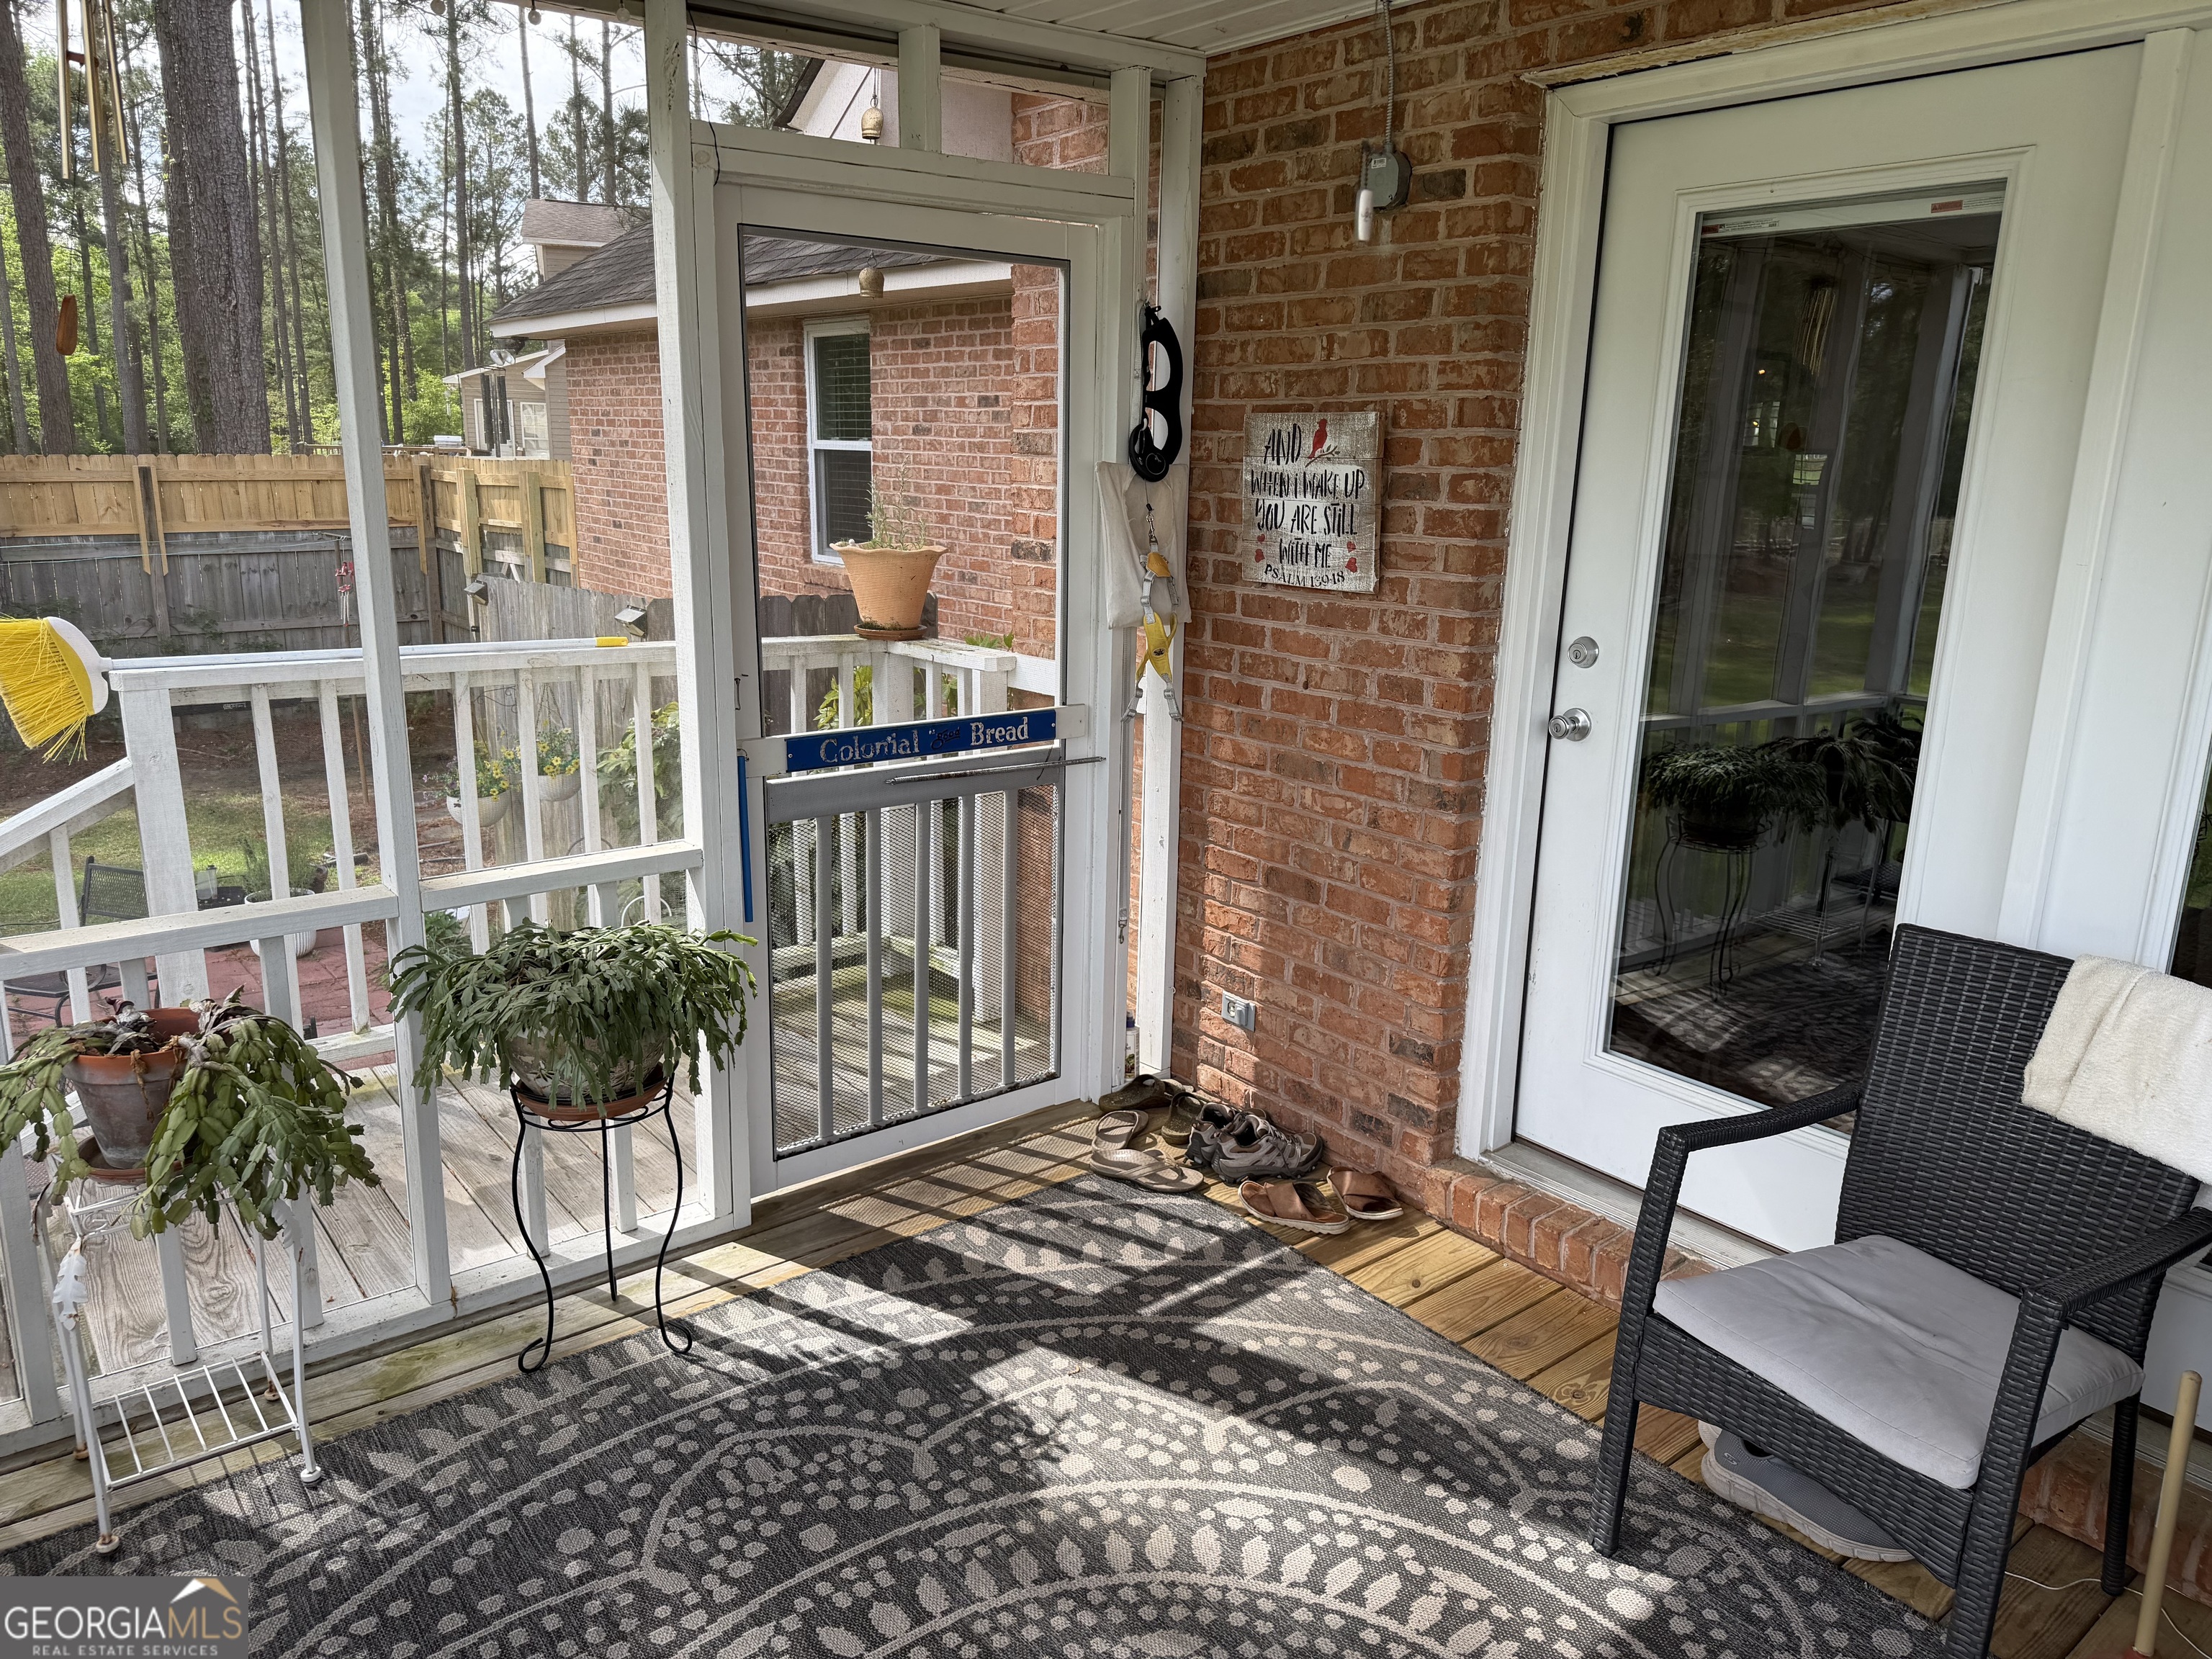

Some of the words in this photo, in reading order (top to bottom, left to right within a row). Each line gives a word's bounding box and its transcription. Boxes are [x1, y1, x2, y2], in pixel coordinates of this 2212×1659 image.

[1264, 423, 1302, 466] AND
[1251, 469, 1290, 498] WHEN
[1303, 469, 1339, 500] WAKE
[1344, 469, 1365, 500] UP
[1255, 498, 1285, 531] YOU
[1290, 504, 1318, 535] ARE
[1314, 542, 1332, 569] ME
[1264, 563, 1306, 587] PSALM
[819, 729, 920, 763] Colonial
[969, 716, 1029, 746] Bread
